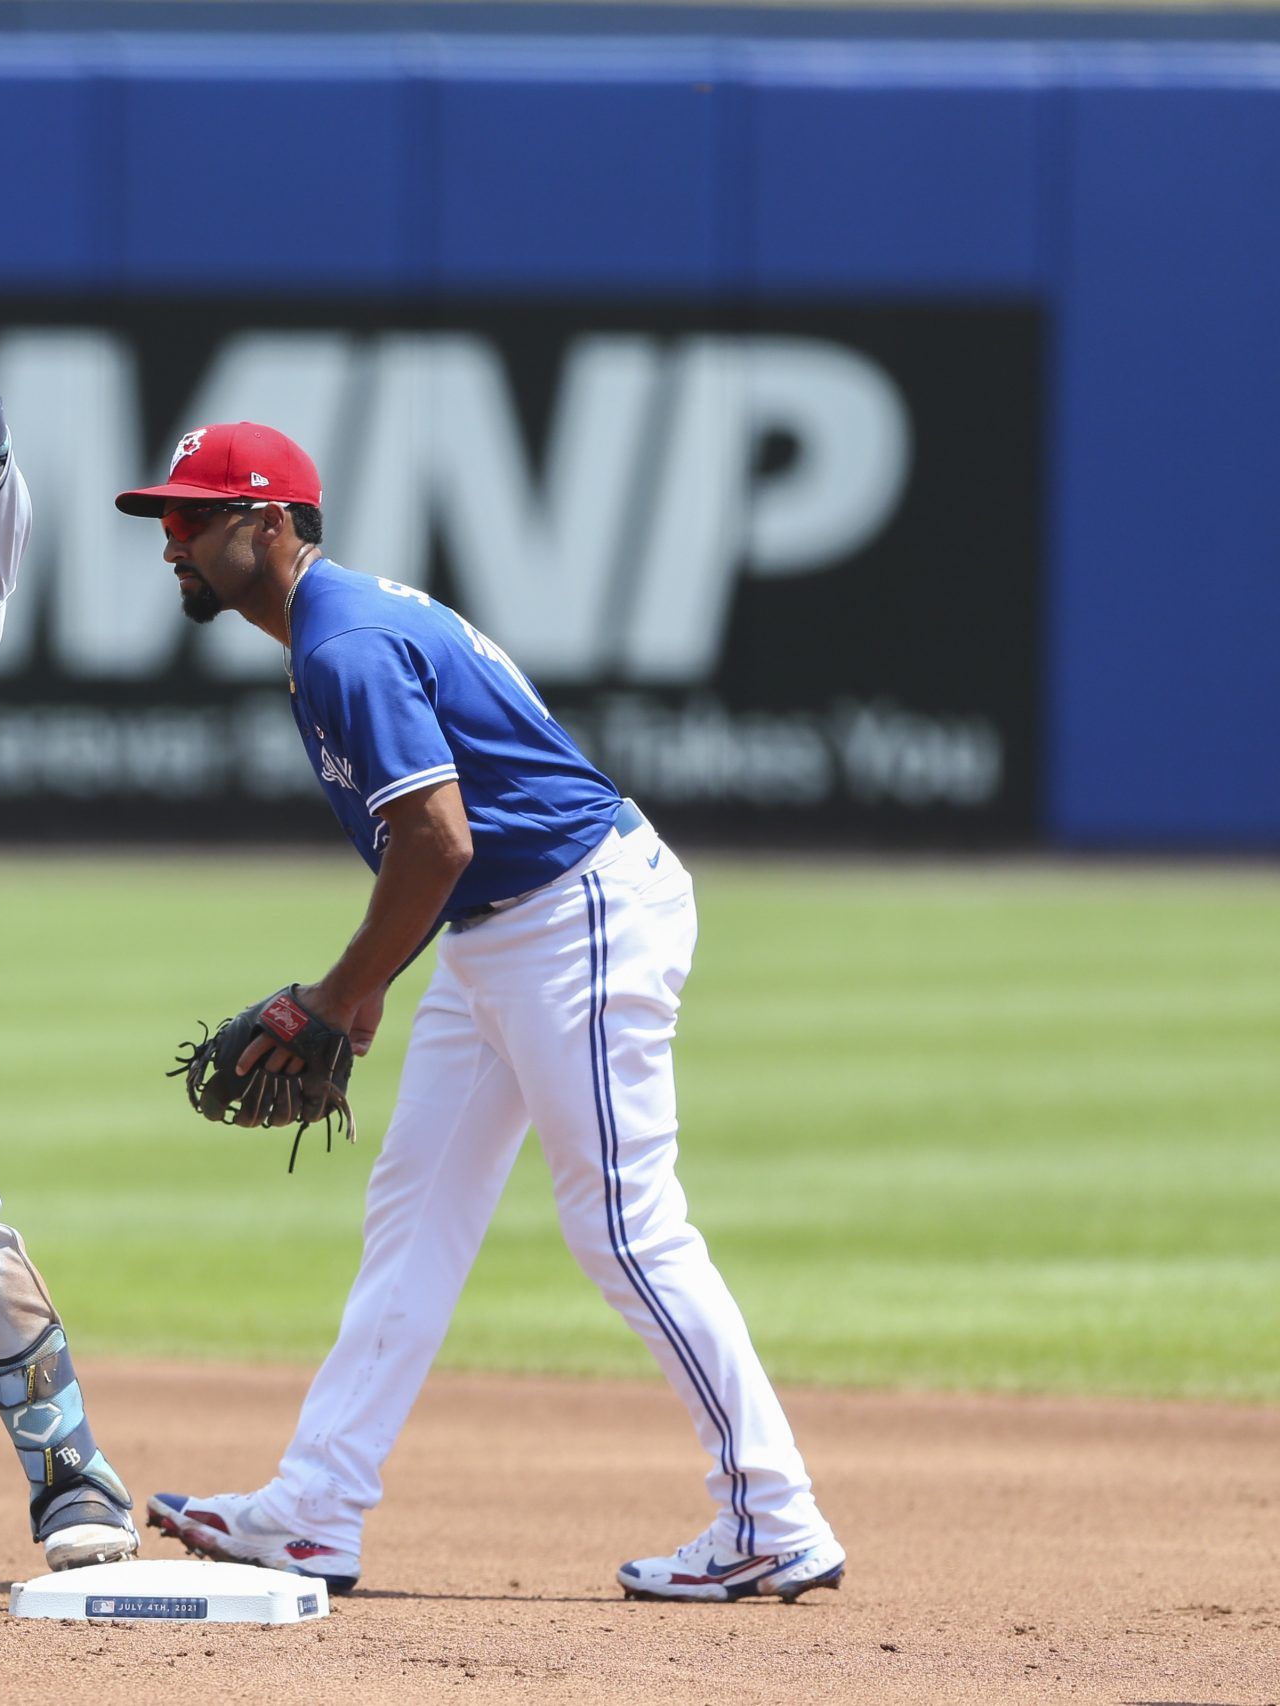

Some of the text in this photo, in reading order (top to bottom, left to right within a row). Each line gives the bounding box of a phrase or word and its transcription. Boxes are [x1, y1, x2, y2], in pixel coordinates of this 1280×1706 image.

[833, 698, 1003, 806] You
[118, 1603, 197, 1612] JULY 4TH, 2021
